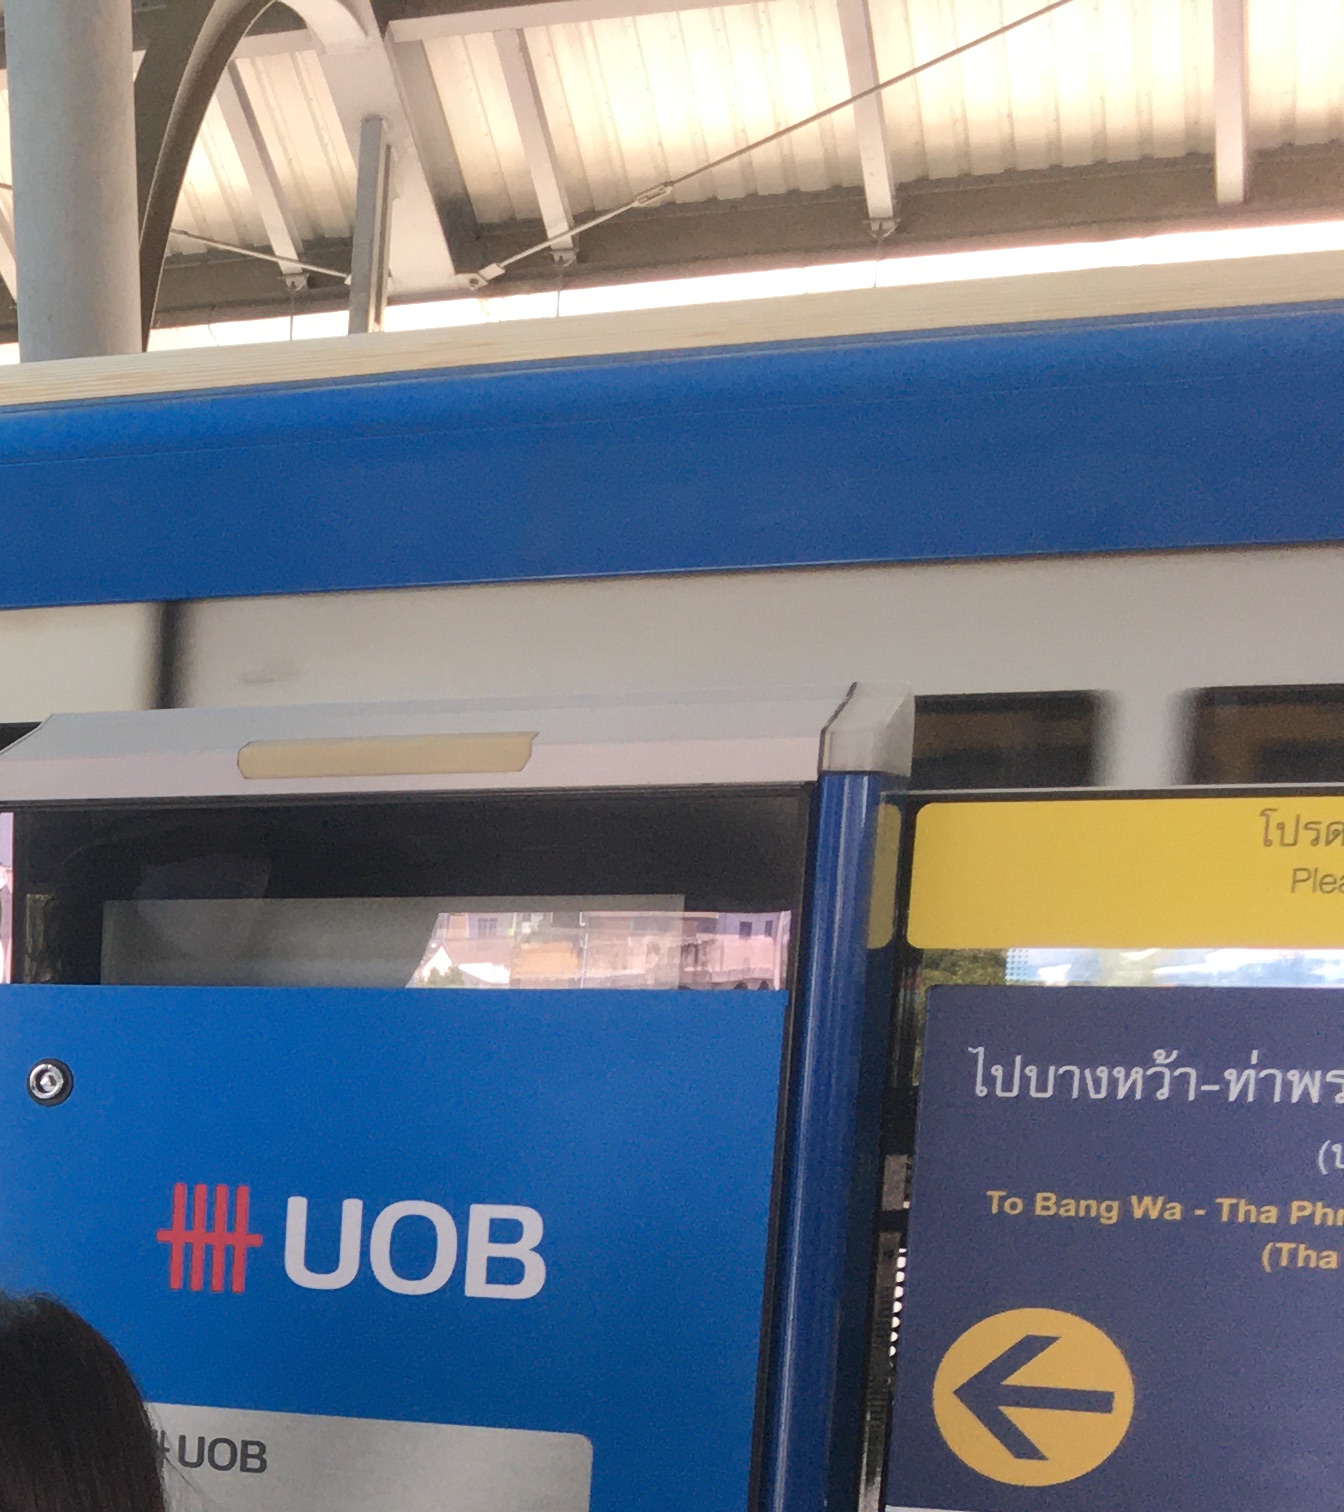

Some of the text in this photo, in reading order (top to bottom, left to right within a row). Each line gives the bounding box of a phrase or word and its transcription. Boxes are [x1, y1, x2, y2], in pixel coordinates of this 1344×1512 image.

[986, 1189, 1024, 1216] To
[1034, 1191, 1120, 1226] Bang
[1130, 1194, 1183, 1220] Wa
[1215, 1197, 1278, 1224] Tha
[283, 1195, 548, 1301] UOB
[1262, 1242, 1339, 1273] (Tha
[177, 1435, 268, 1474] UOB
